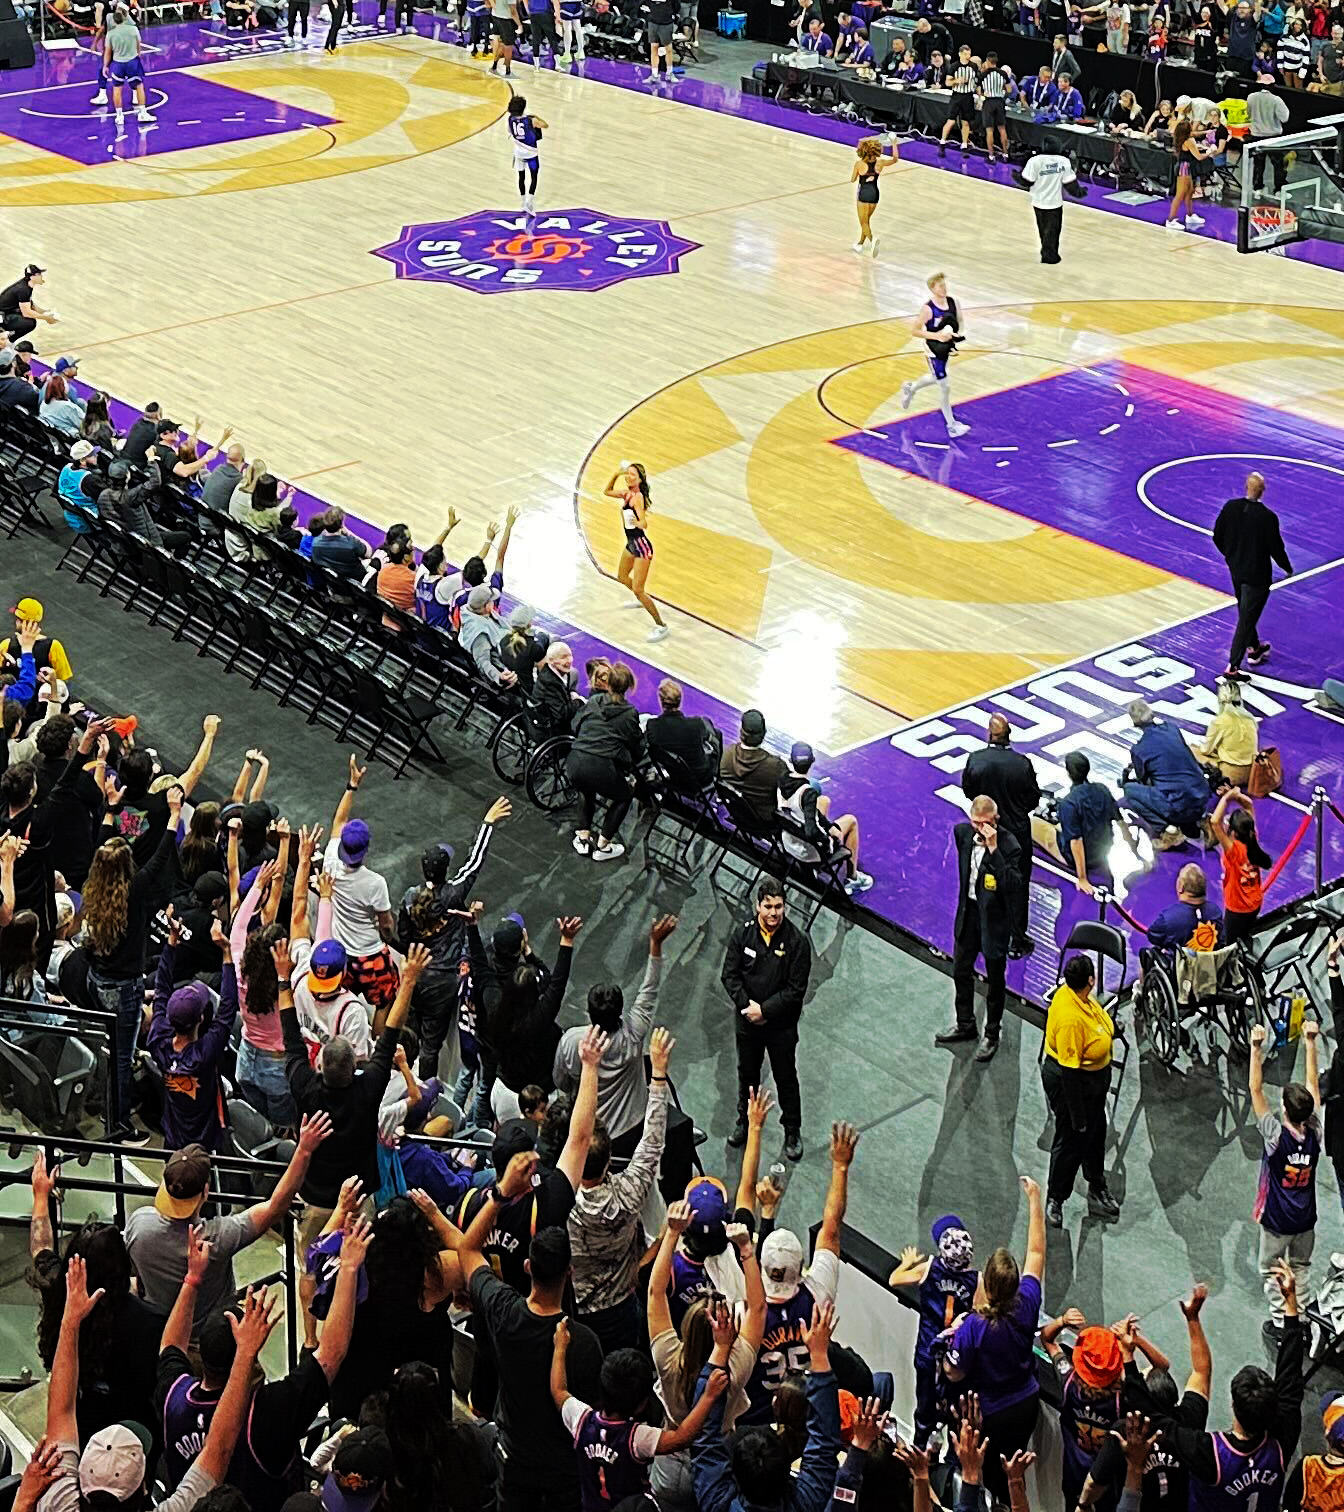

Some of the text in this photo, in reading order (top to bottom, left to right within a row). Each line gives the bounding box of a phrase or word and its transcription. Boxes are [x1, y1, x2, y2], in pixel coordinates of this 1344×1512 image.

[417, 239, 544, 284] SUNS
[491, 216, 658, 271] VALLEY
[890, 643, 1196, 774] SUNS
[760, 1346, 812, 1391] 35
[175, 1432, 205, 1461] BOO
[583, 1443, 618, 1465] BOOKER
[1225, 1469, 1278, 1497] BOOKER
